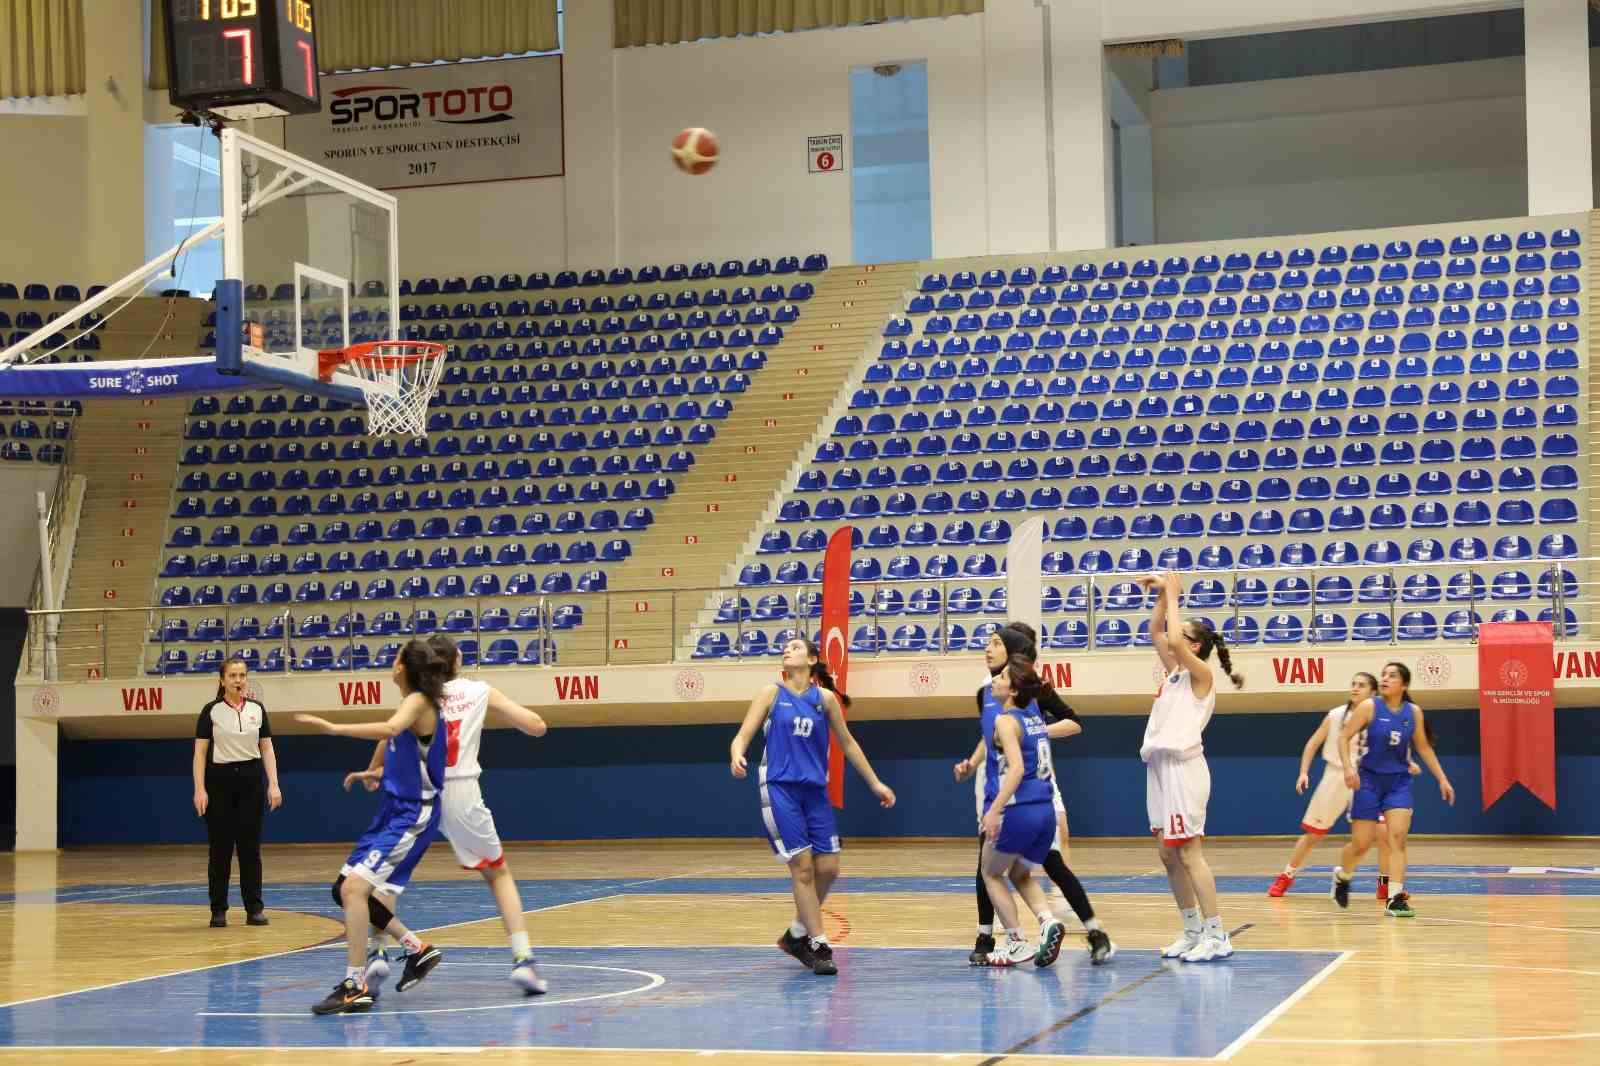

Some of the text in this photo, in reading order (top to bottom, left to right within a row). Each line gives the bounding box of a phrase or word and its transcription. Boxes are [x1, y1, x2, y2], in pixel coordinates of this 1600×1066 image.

[223, 29, 252, 85] 7
[297, 40, 313, 97] 7
[324, 133, 521, 160] SPORUN VE SPORCUNUN DESTEKÇİSİ
[408, 162, 437, 175] 2017
[822, 155, 829, 168] 6
[89, 377, 122, 388] SURE
[147, 374, 179, 386] SHOT
[1041, 663, 1072, 688] AN
[1272, 658, 1324, 684] VAN
[121, 688, 162, 711] VAN
[339, 681, 381, 705] VAN
[555, 676, 599, 700] VAN
[793, 716, 813, 737] 10
[1389, 731, 1401, 745] 5
[1170, 813, 1185, 835] 13
